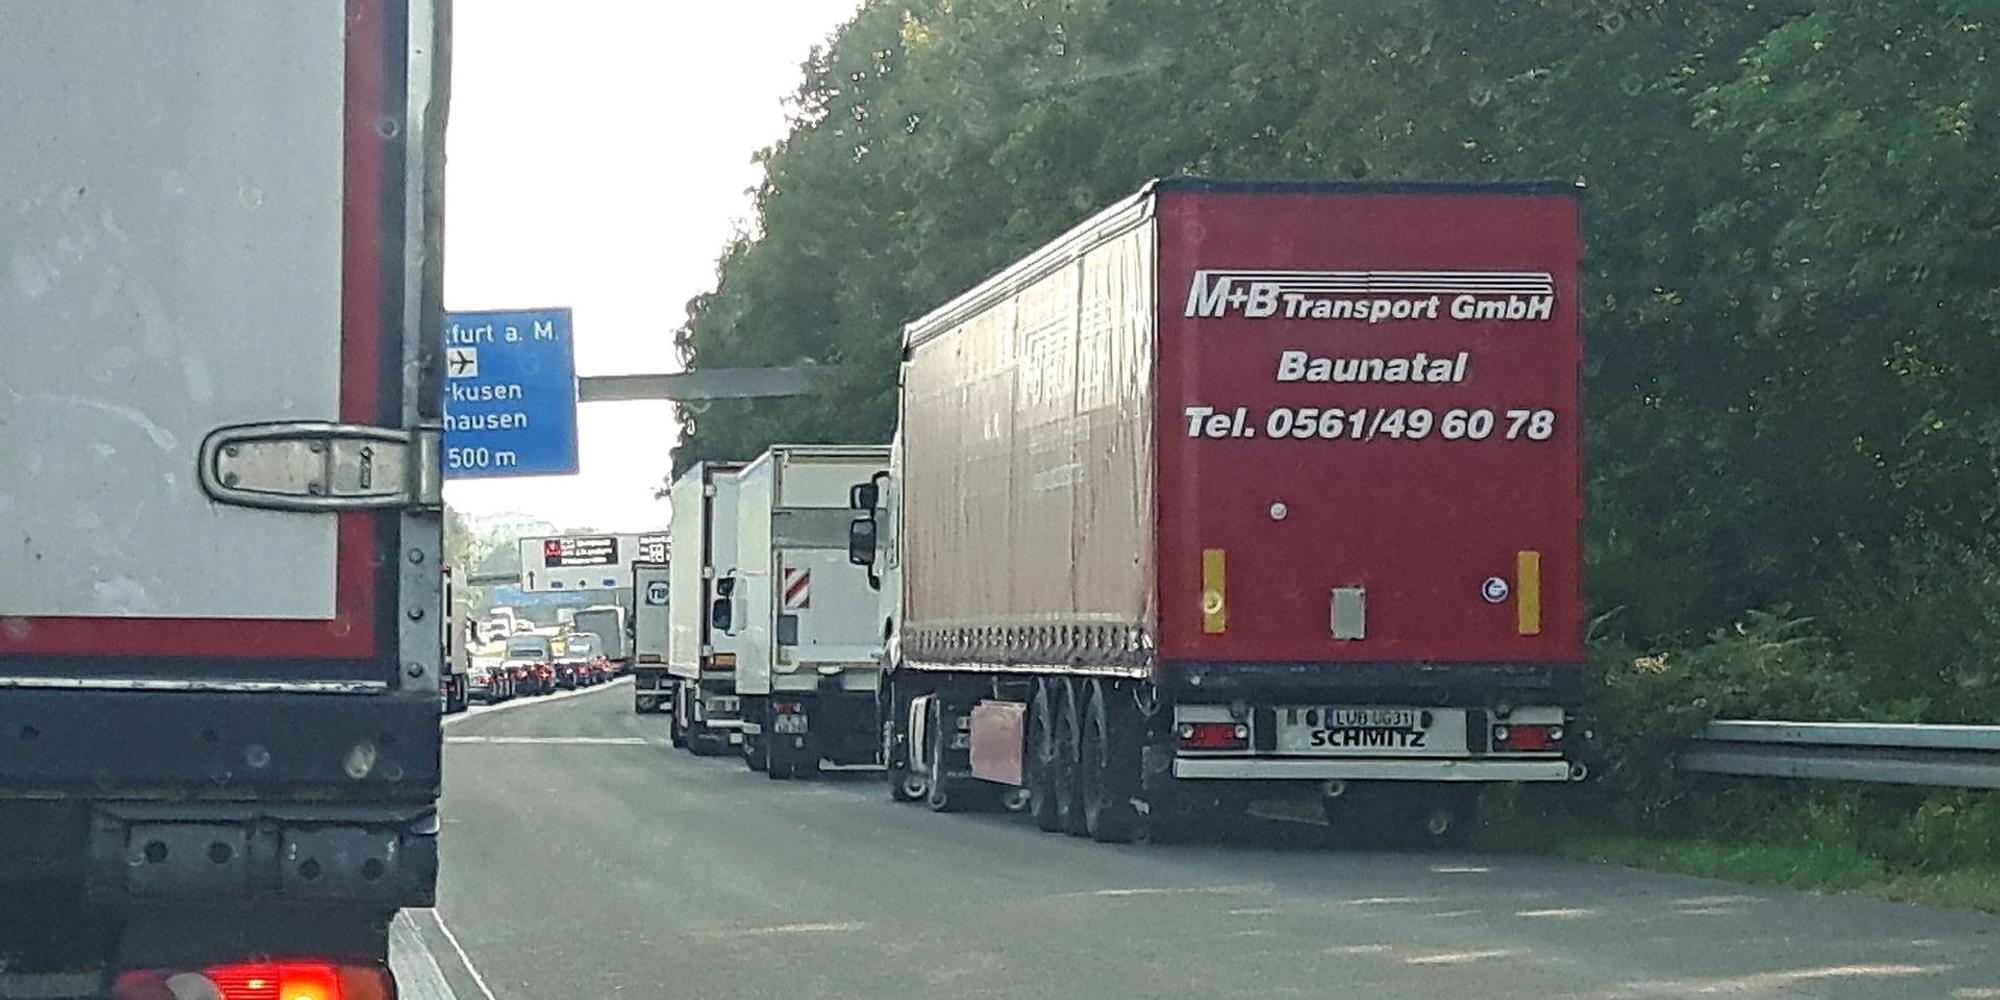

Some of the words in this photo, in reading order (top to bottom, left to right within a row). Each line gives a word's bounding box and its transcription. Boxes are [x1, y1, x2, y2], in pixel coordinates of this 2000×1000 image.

[1185, 270, 1281, 318] M+B
[1283, 293, 1440, 323] Transport
[1450, 295, 1554, 320] GmbH
[505, 326, 524, 343] a.
[534, 320, 560, 341] M.
[1277, 350, 1469, 383] Baunatal
[1184, 406, 1256, 438] Tel.
[1266, 407, 1434, 442] 0561/49
[1441, 408, 1495, 440] 60
[1505, 408, 1555, 441] 78
[495, 450, 516, 467] m
[1310, 727, 1426, 747] SCHMITZ
